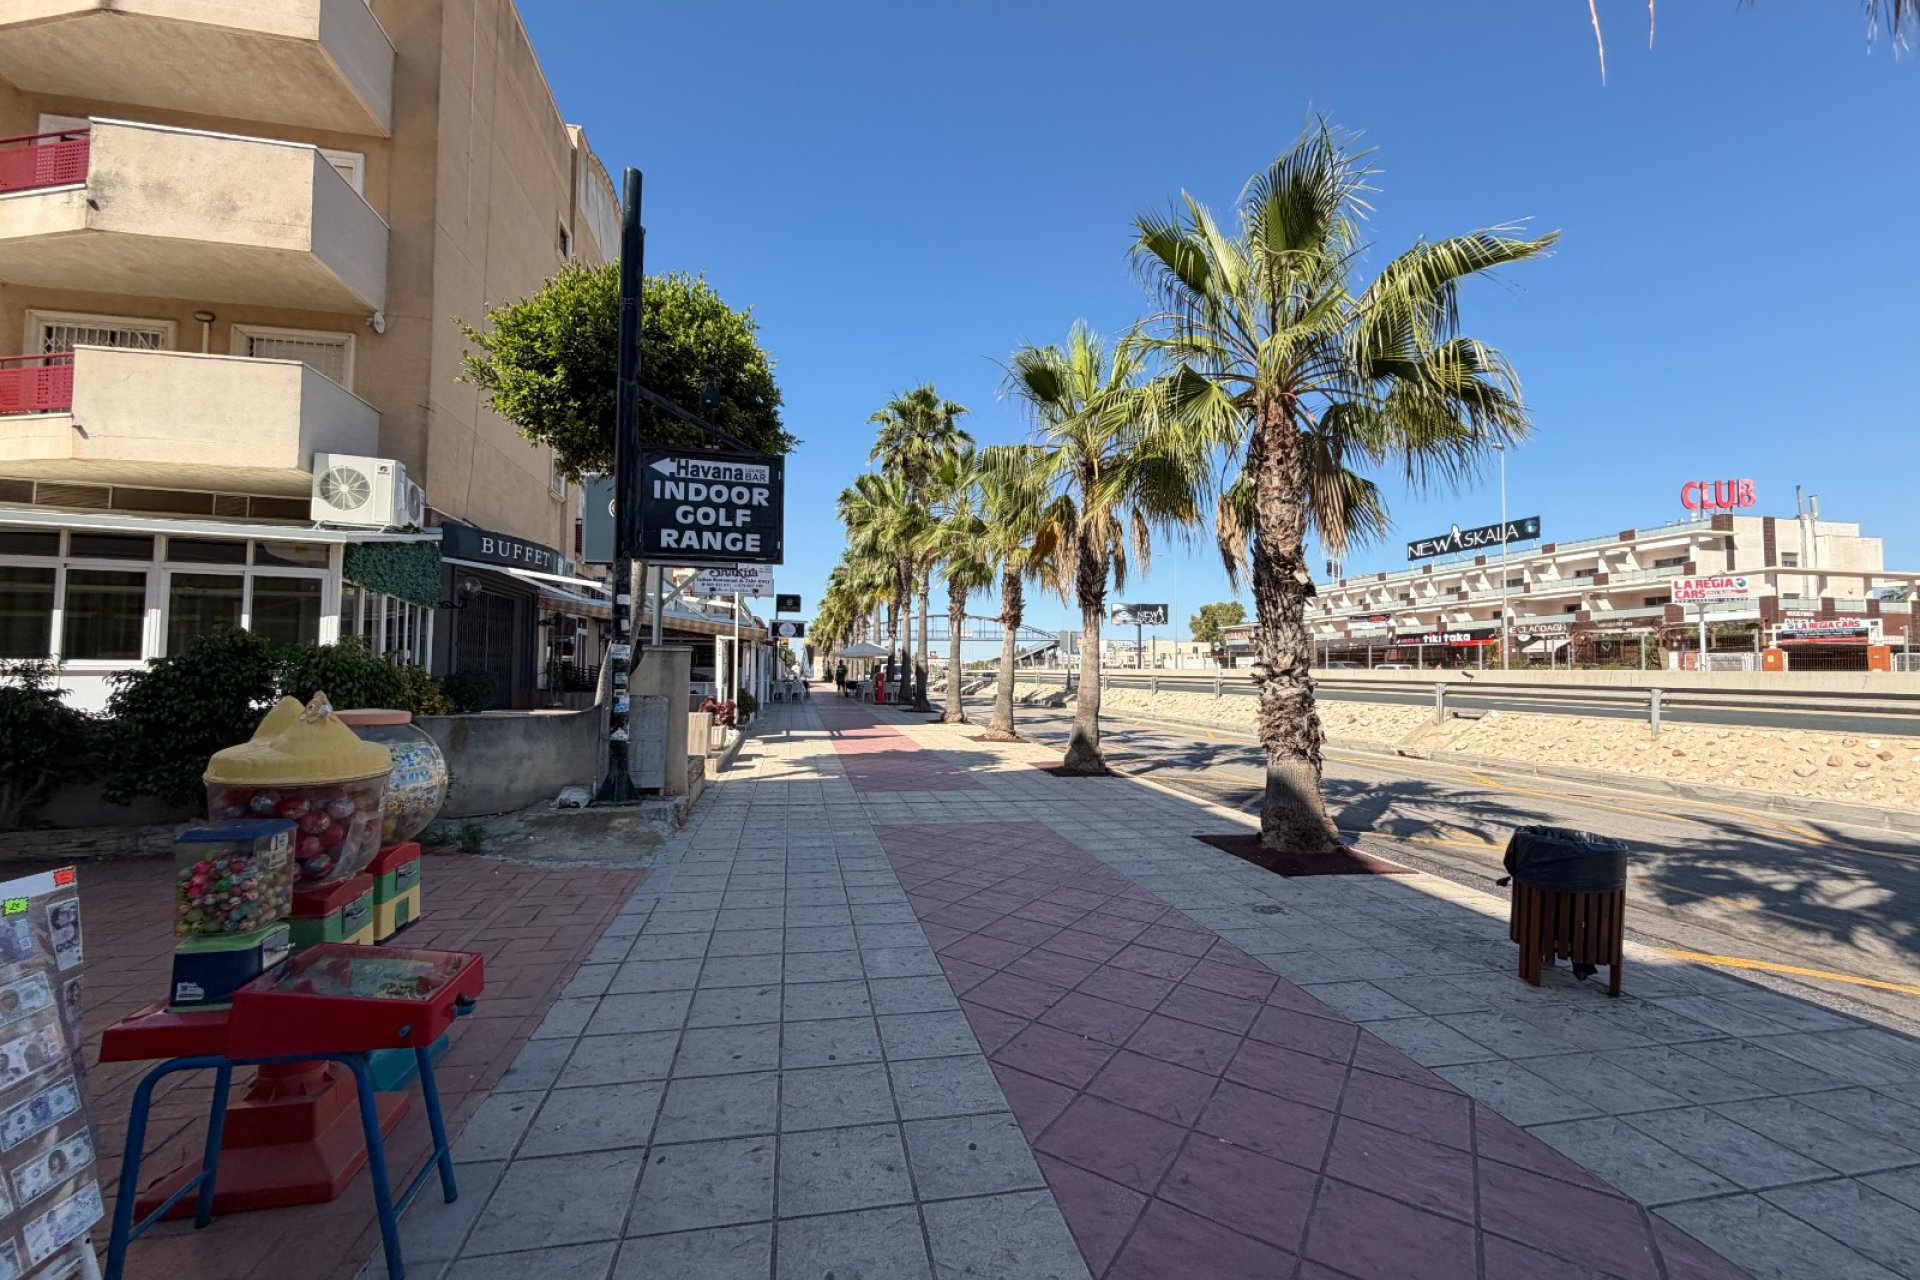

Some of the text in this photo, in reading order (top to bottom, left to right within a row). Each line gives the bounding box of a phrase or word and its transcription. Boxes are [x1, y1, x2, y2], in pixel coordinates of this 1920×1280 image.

[677, 459, 743, 480] Havana
[745, 472, 767, 482] BAR
[653, 480, 770, 507] INDOOR
[1681, 479, 1757, 510] CLUB
[675, 505, 751, 528] GOLF
[660, 528, 761, 552] RANGE
[1408, 524, 1519, 558] NEW SKALA
[481, 538, 551, 567] BUFFET
[1674, 578, 1734, 590] LA REGIA
[1675, 589, 1706, 599] CARS
[1795, 621, 1807, 630] LA
[1836, 620, 1861, 628] CARS
[1423, 632, 1442, 643] tiki
[1444, 633, 1471, 643] taka
